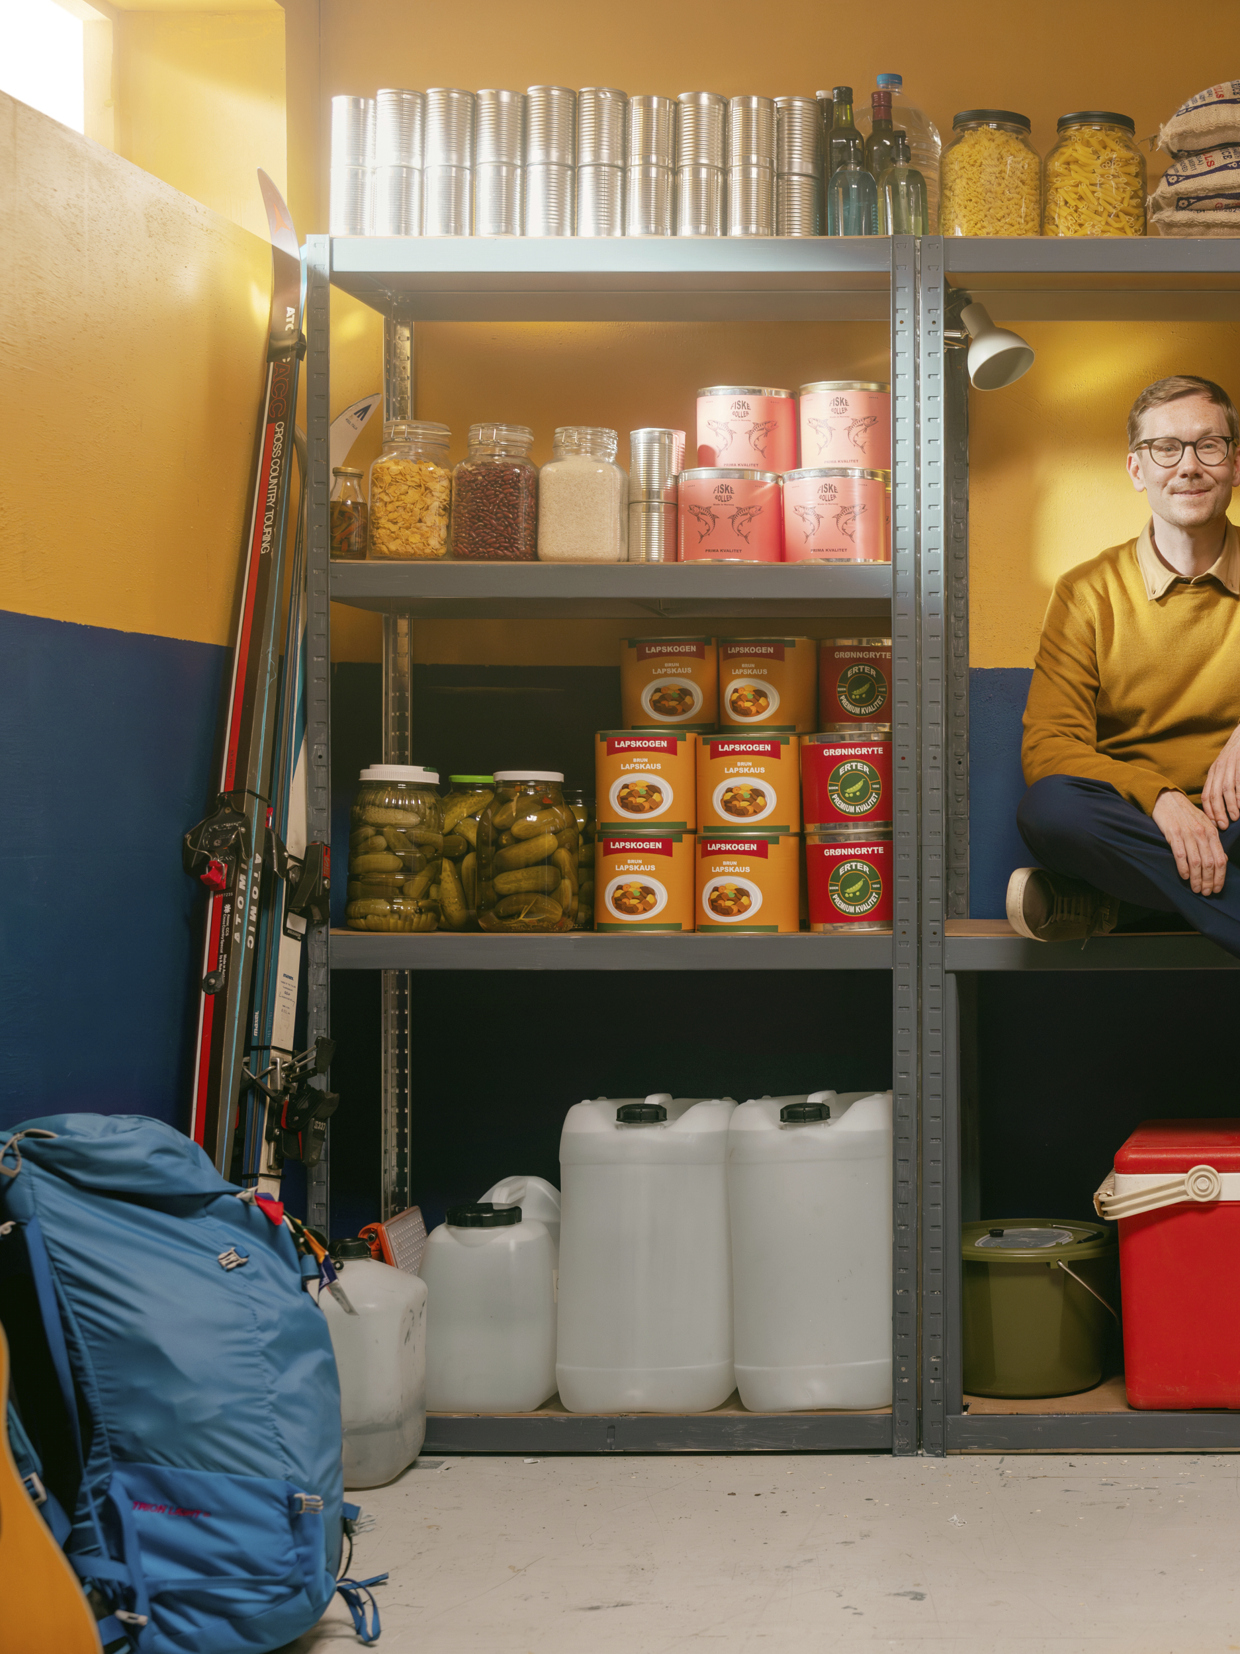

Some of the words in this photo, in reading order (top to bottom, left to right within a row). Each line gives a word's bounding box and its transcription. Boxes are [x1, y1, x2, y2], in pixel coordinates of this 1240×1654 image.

[730, 400, 752, 411] FISKE
[829, 396, 850, 407] FISKE
[272, 421, 285, 458] CROSS
[267, 459, 280, 507] COUNTRY
[713, 483, 735, 494] FISKE
[817, 483, 839, 494] FISKE
[261, 509, 275, 554] TOURING
[645, 645, 697, 654] LAPSKOGEN
[727, 646, 774, 654] LAPSKOGEN
[834, 651, 892, 659] GRØNNGRYTE
[652, 667, 692, 675] LAPSKAUS
[847, 665, 876, 678] ERTER
[840, 694, 860, 714] PREMIUM
[860, 695, 884, 715] KVALITET
[615, 740, 668, 748] LAPSKOGEN
[718, 744, 771, 752] LAPSKOGEN
[823, 747, 884, 756] GRØNNGRYTE
[839, 762, 870, 776] ERTER
[831, 793, 855, 813] PREMIUM
[856, 792, 878, 813] KVALITET
[707, 843, 757, 851] LAPSKOGEN
[824, 847, 884, 856] GRØNNGRYTE
[839, 862, 870, 876] ERTER
[234, 863, 248, 943] ATOMI
[247, 853, 262, 949] ATOMIC
[832, 894, 855, 913] PREMIUM
[856, 892, 879, 913] KVALITET
